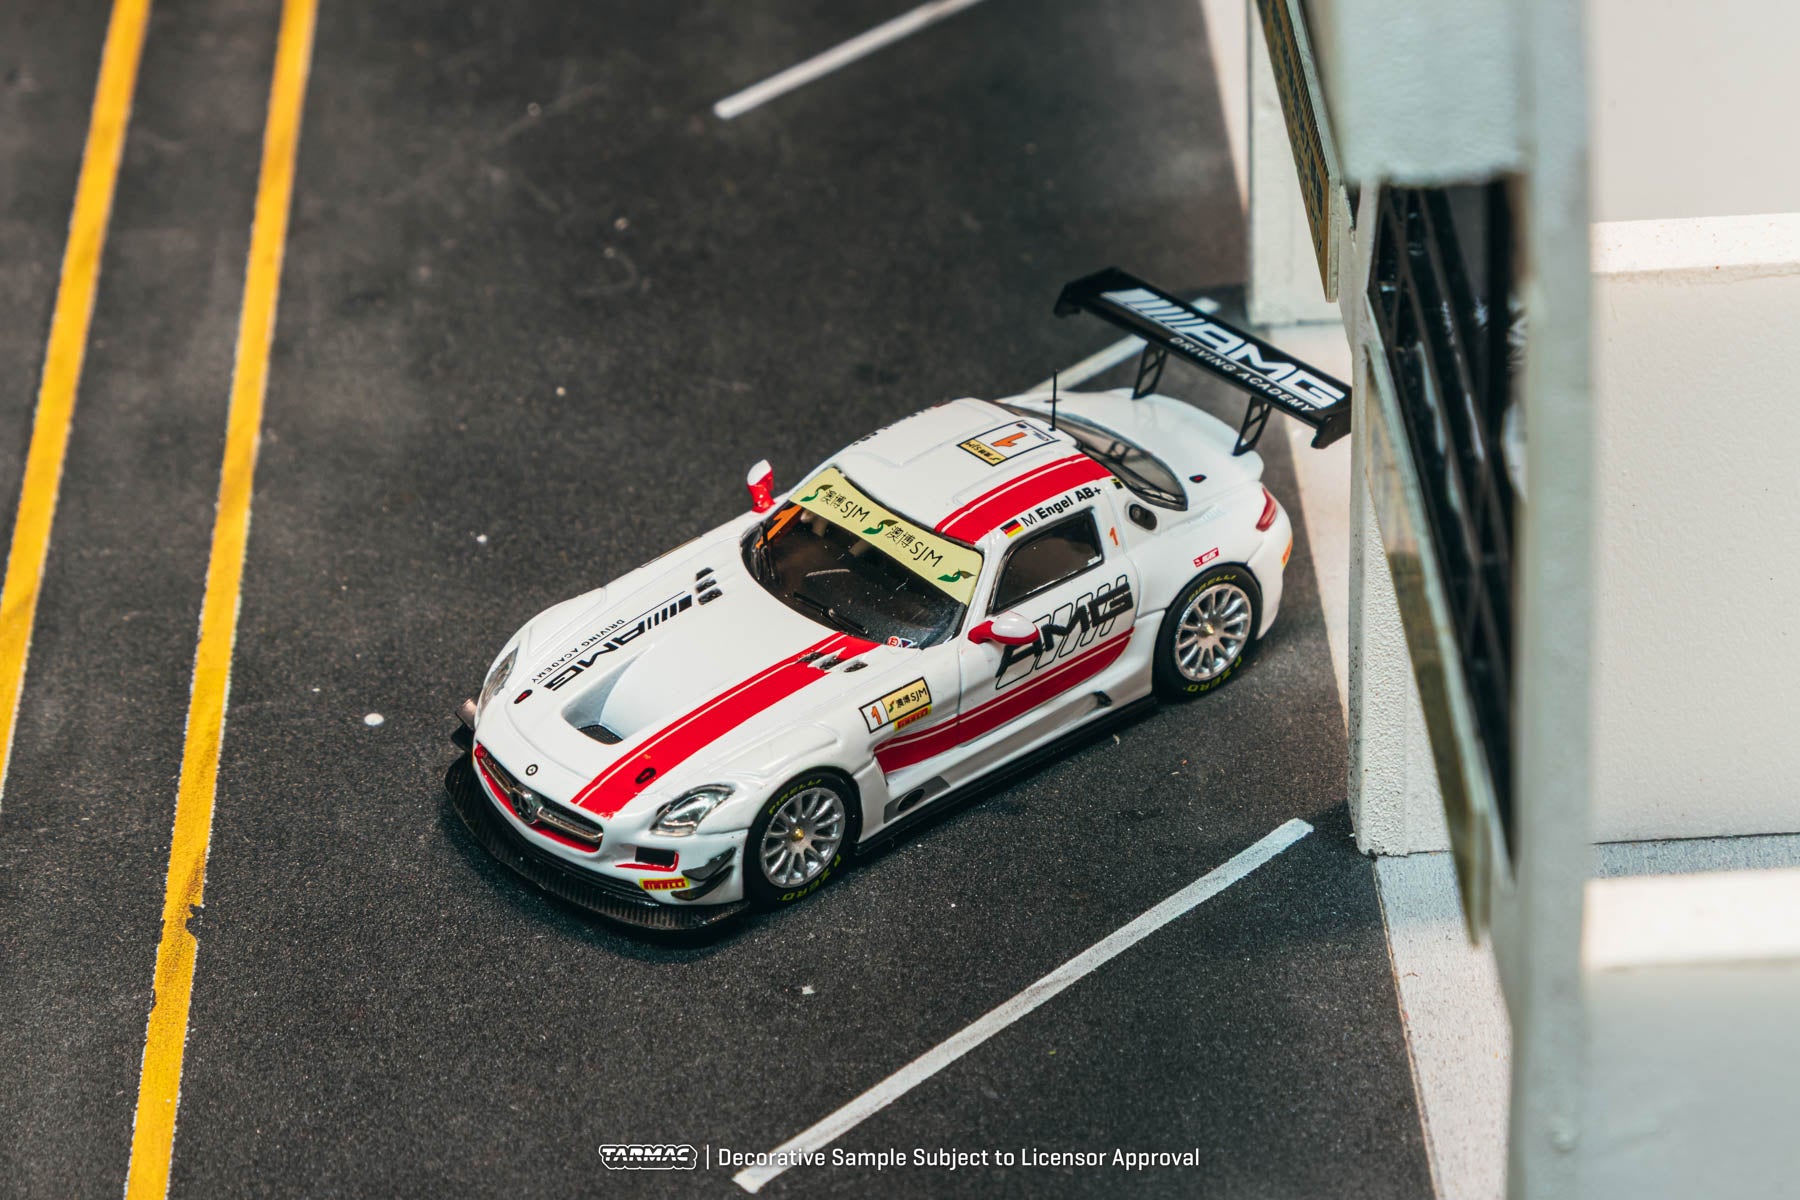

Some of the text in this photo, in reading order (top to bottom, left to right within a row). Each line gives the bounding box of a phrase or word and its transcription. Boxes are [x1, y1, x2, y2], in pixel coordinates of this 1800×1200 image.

[1169, 336, 1315, 413] DRIVING ACADEMY
[1021, 486, 1101, 527] M Engel AB+
[1109, 527, 1119, 546] 1
[532, 619, 625, 684] DRIVING ACADEMY
[871, 705, 882, 725] 1
